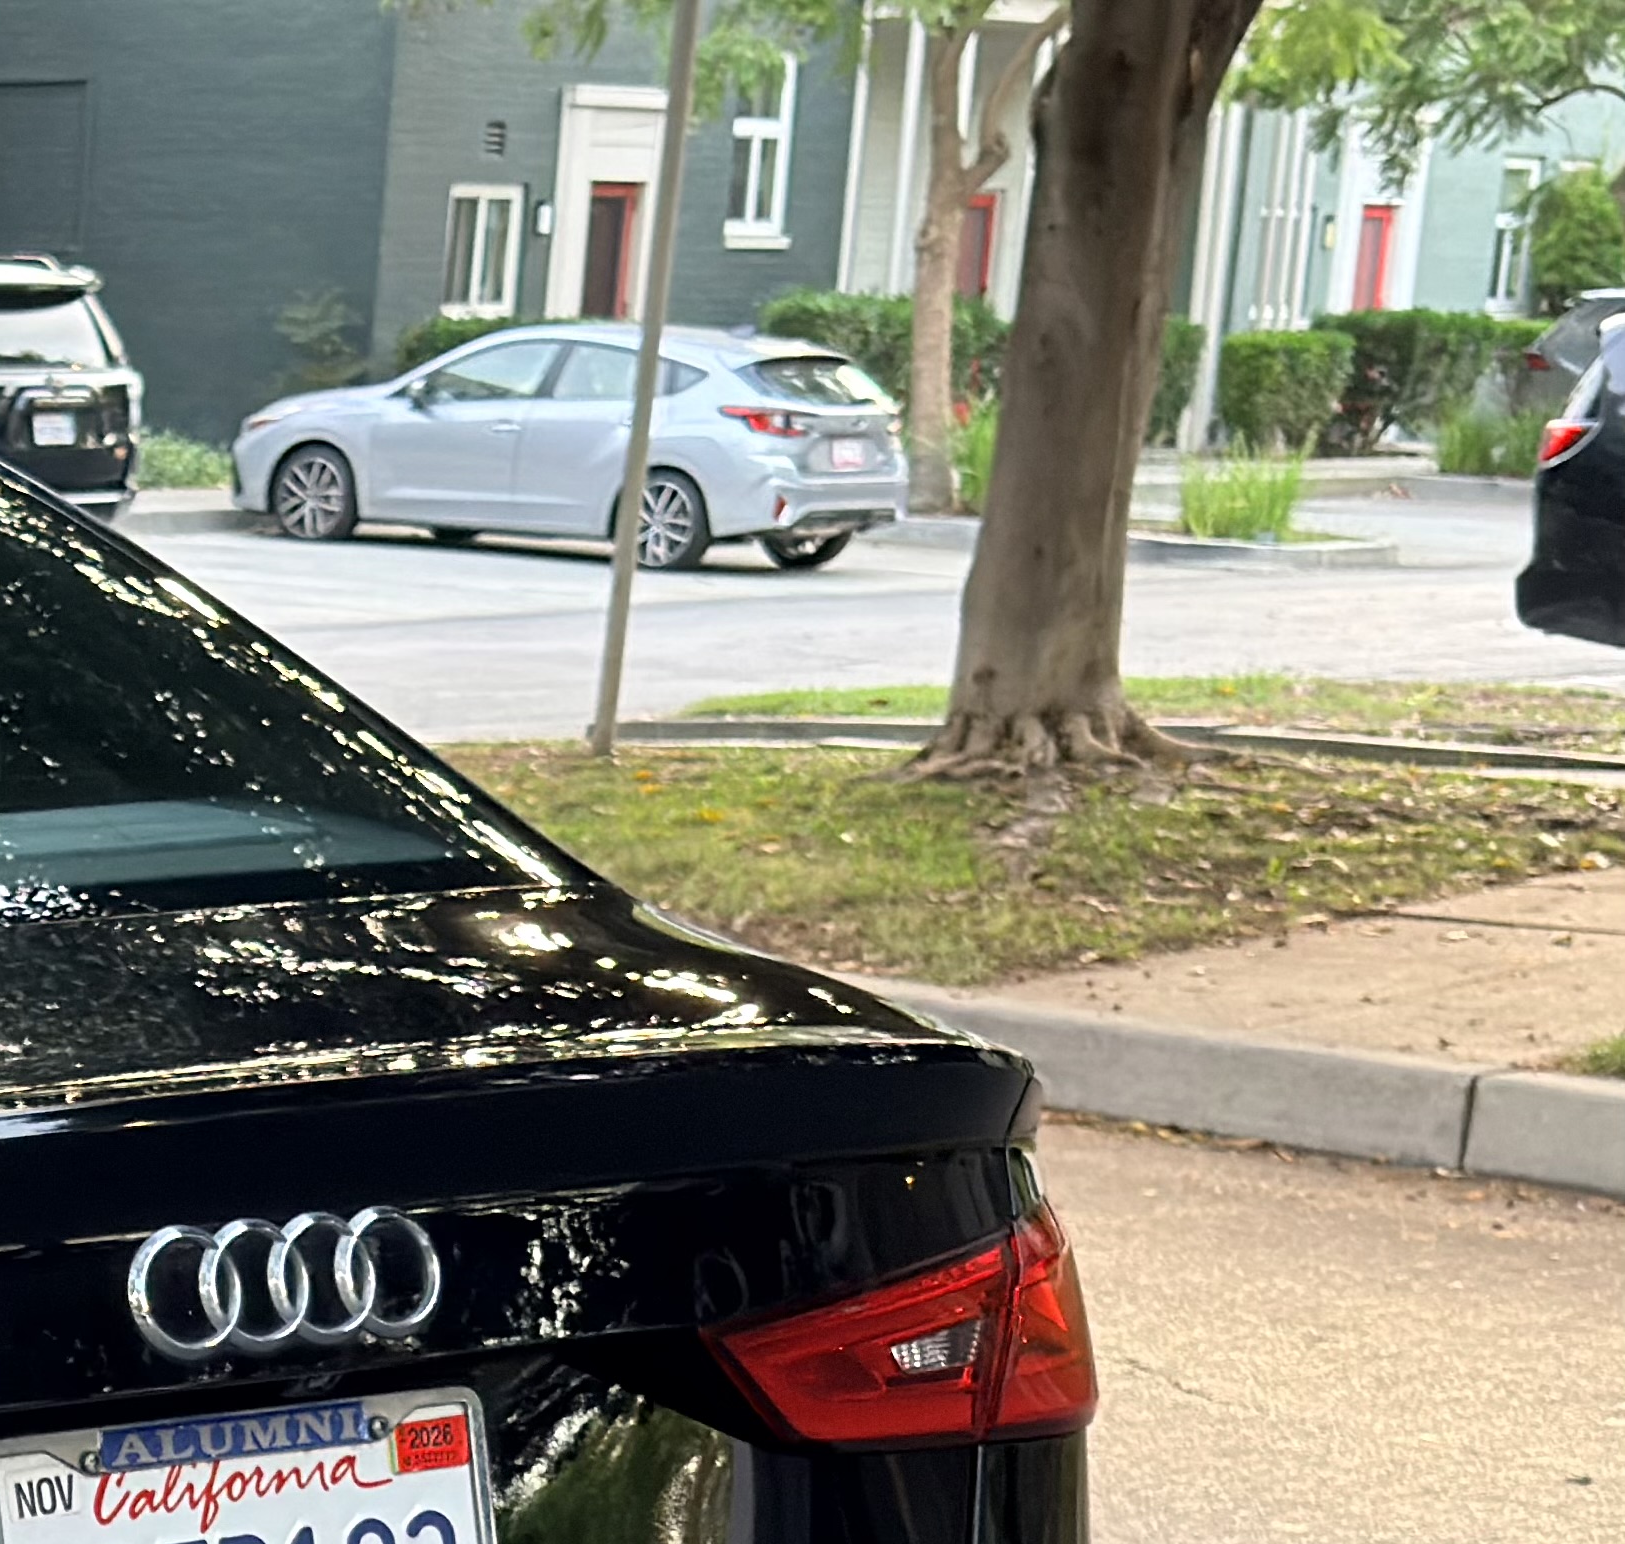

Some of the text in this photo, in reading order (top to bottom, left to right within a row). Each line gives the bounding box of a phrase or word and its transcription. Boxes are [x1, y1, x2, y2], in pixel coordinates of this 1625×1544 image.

[111, 1407, 361, 1467] ALUMNI
[13, 1474, 75, 1519] NOV
[93, 1453, 393, 1533] California
